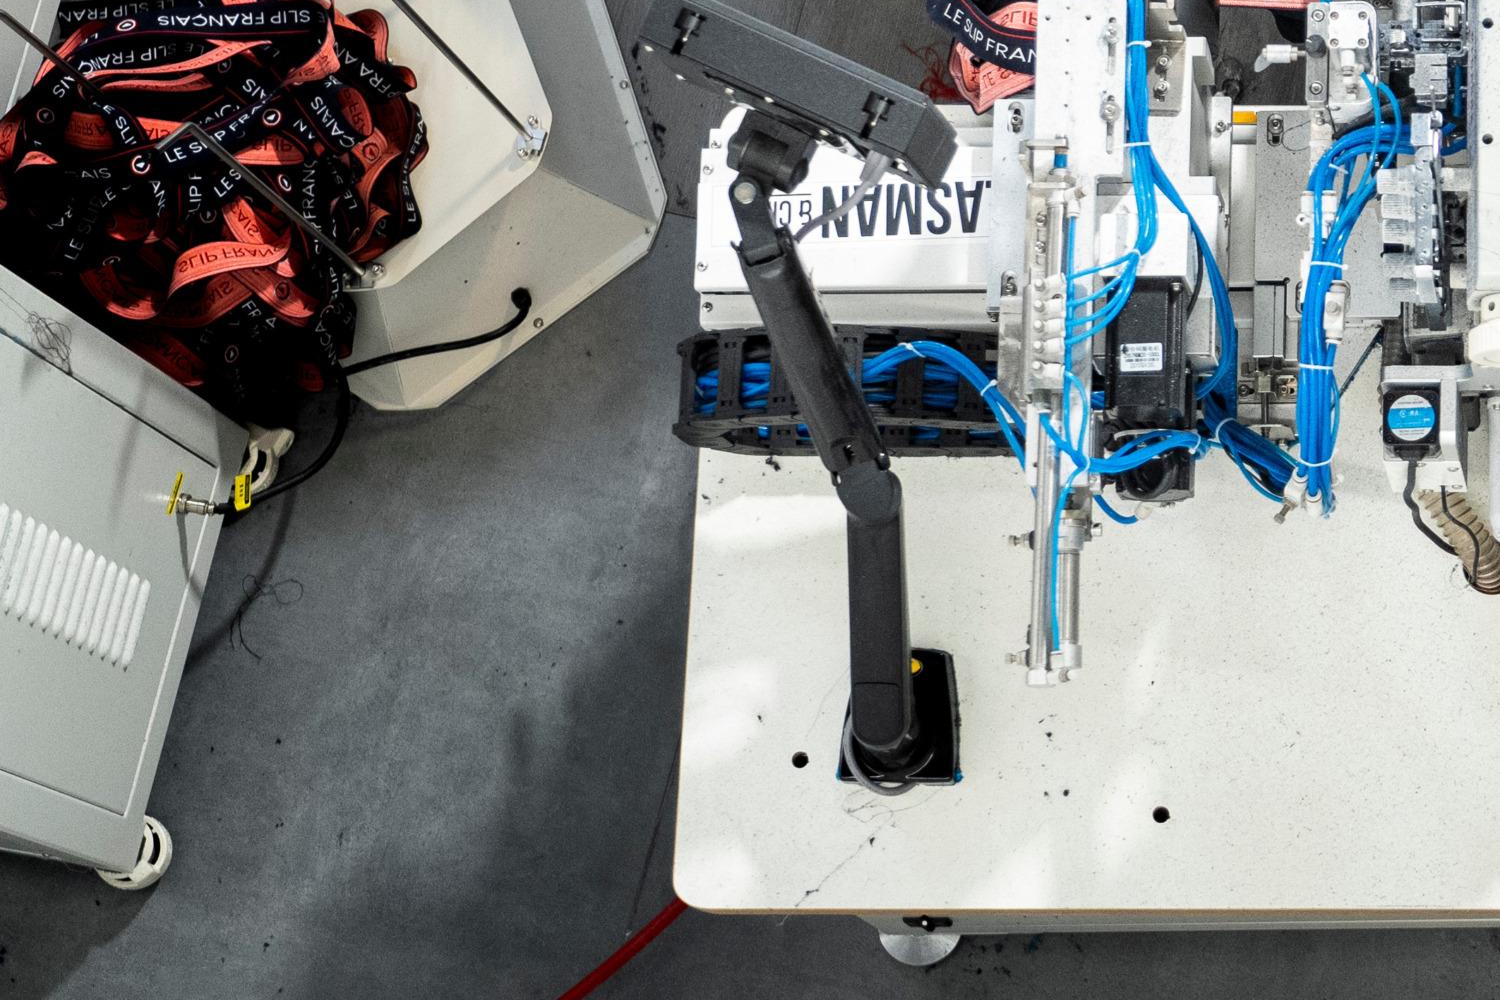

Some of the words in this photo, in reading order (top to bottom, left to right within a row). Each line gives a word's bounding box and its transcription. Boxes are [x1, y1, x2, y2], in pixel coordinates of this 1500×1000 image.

[58, 6, 109, 23] FRAN
[113, 3, 149, 18] SLIP
[157, 11, 265, 27] FRANÇAIS
[270, 10, 311, 25] SLIP
[943, 2, 964, 26] LE
[964, 18, 984, 44] SLIP
[985, 38, 1038, 63] FRAN
[78, 49, 135, 75] FRANÇ
[164, 147, 187, 163] LE
[214, 176, 234, 198] LE
[406, 201, 417, 223] LE
